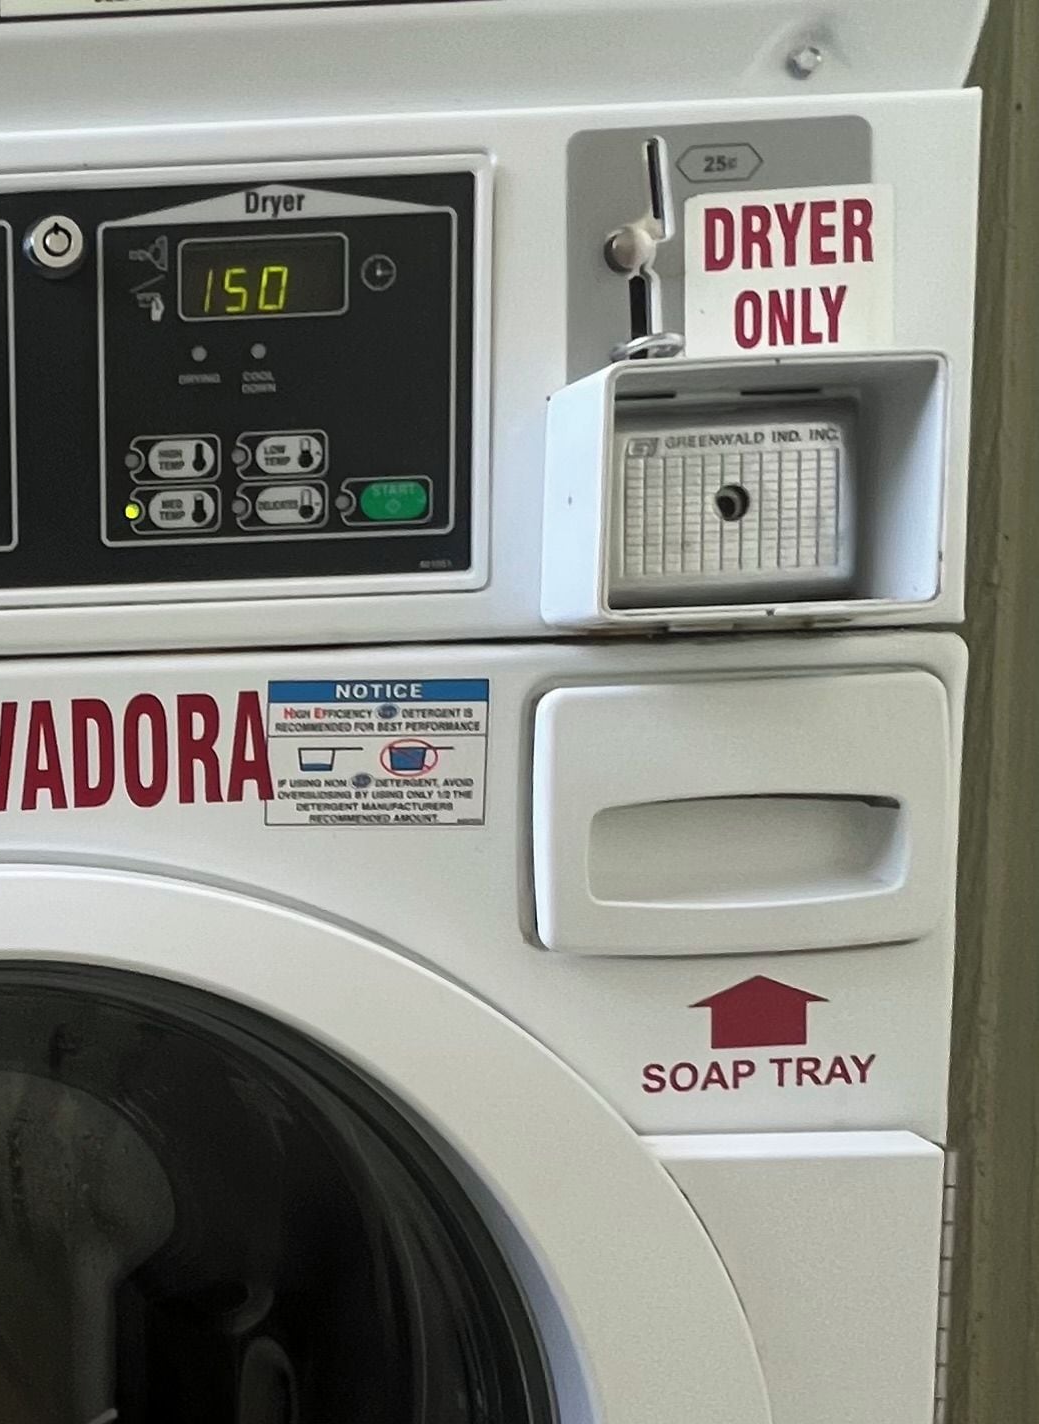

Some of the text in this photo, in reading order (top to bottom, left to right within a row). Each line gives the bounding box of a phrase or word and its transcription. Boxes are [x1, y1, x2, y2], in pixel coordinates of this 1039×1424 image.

[244, 190, 306, 218] Dryer
[704, 198, 874, 272] DRYER
[203, 265, 289, 314] 150
[734, 285, 847, 349] ONLY
[664, 431, 765, 449] GREENWALD
[334, 683, 424, 699] NOTICE
[354, 721, 375, 732] FOR
[377, 721, 403, 732] BEST
[405, 720, 481, 732] PERFORMANCE
[401, 707, 461, 719] DETERGENT
[641, 1053, 877, 1093] SOAP TRAY
